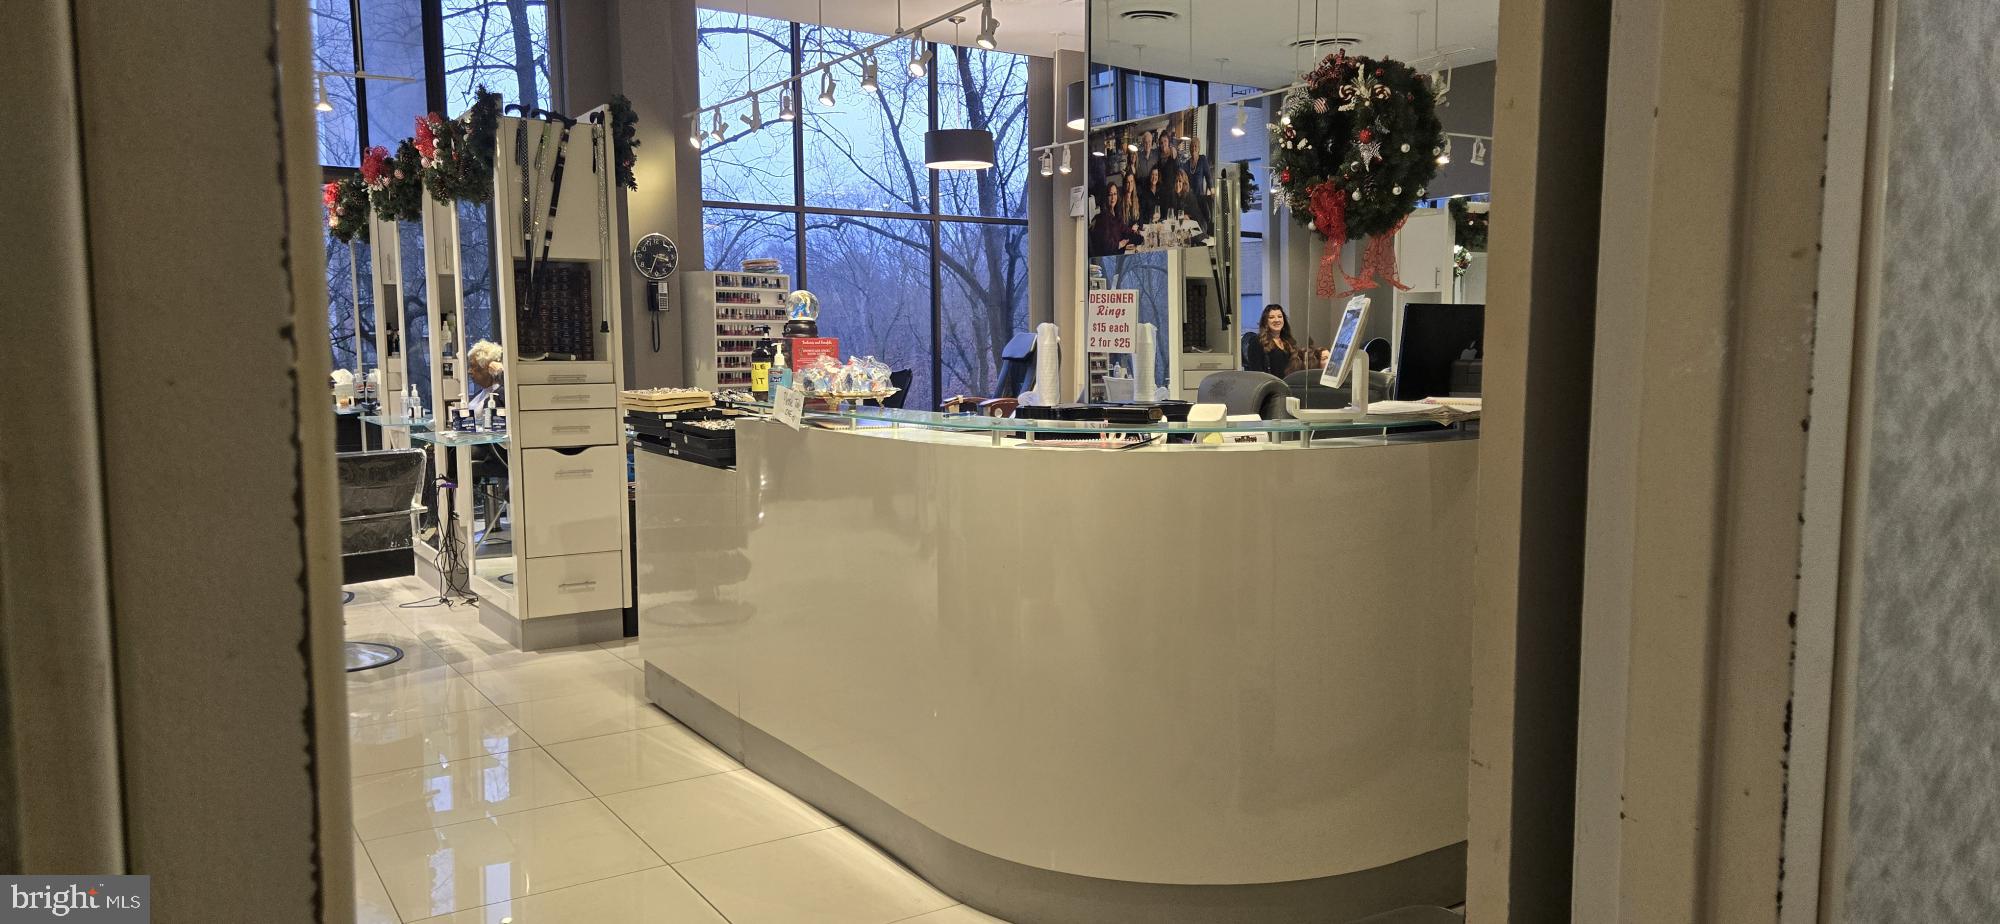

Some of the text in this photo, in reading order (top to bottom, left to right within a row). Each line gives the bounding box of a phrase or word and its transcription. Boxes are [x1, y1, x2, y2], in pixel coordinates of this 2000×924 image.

[1090, 293, 1134, 304] DESIGNER
[1096, 305, 1125, 318] Rings
[1092, 322, 1129, 333] $15 each
[1090, 337, 1130, 348] 2 for $25
